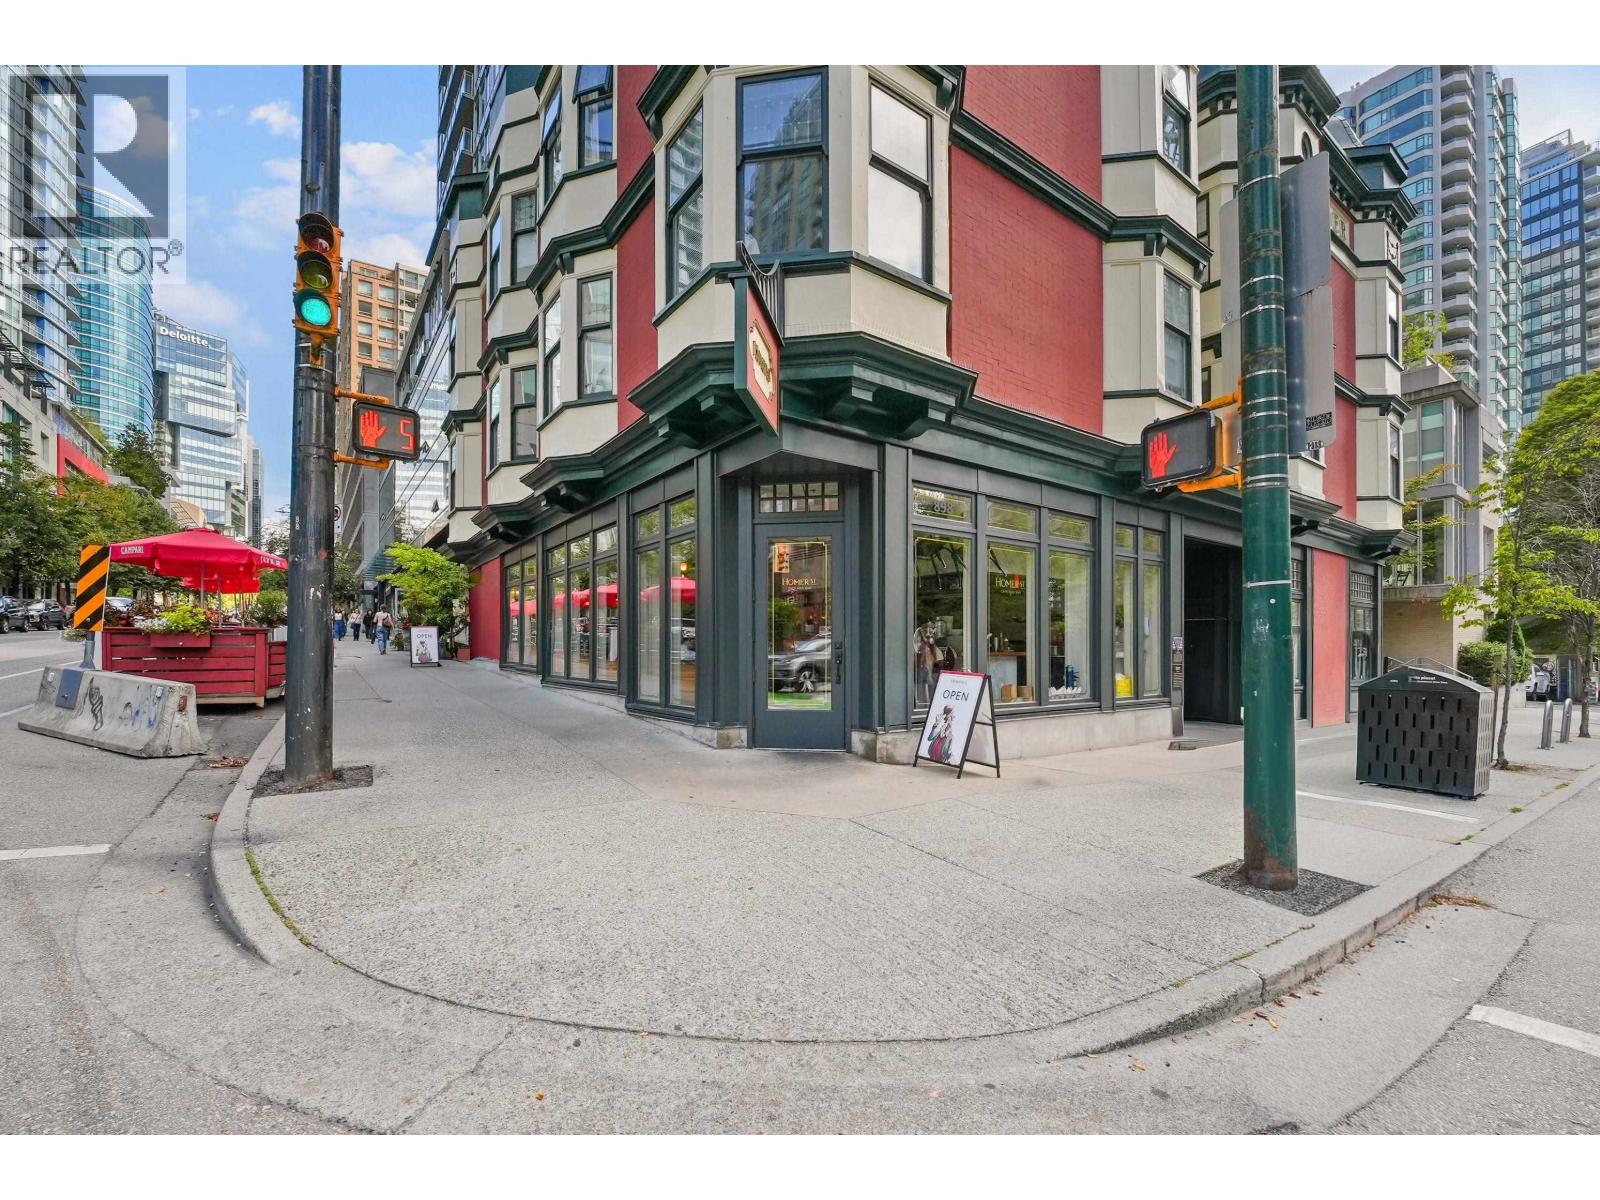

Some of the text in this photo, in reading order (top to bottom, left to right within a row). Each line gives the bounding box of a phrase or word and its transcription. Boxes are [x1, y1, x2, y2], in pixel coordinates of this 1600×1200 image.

[400, 416, 415, 451] 5
[120, 545, 145, 555] CAMPARI
[942, 689, 970, 702] OPEN
